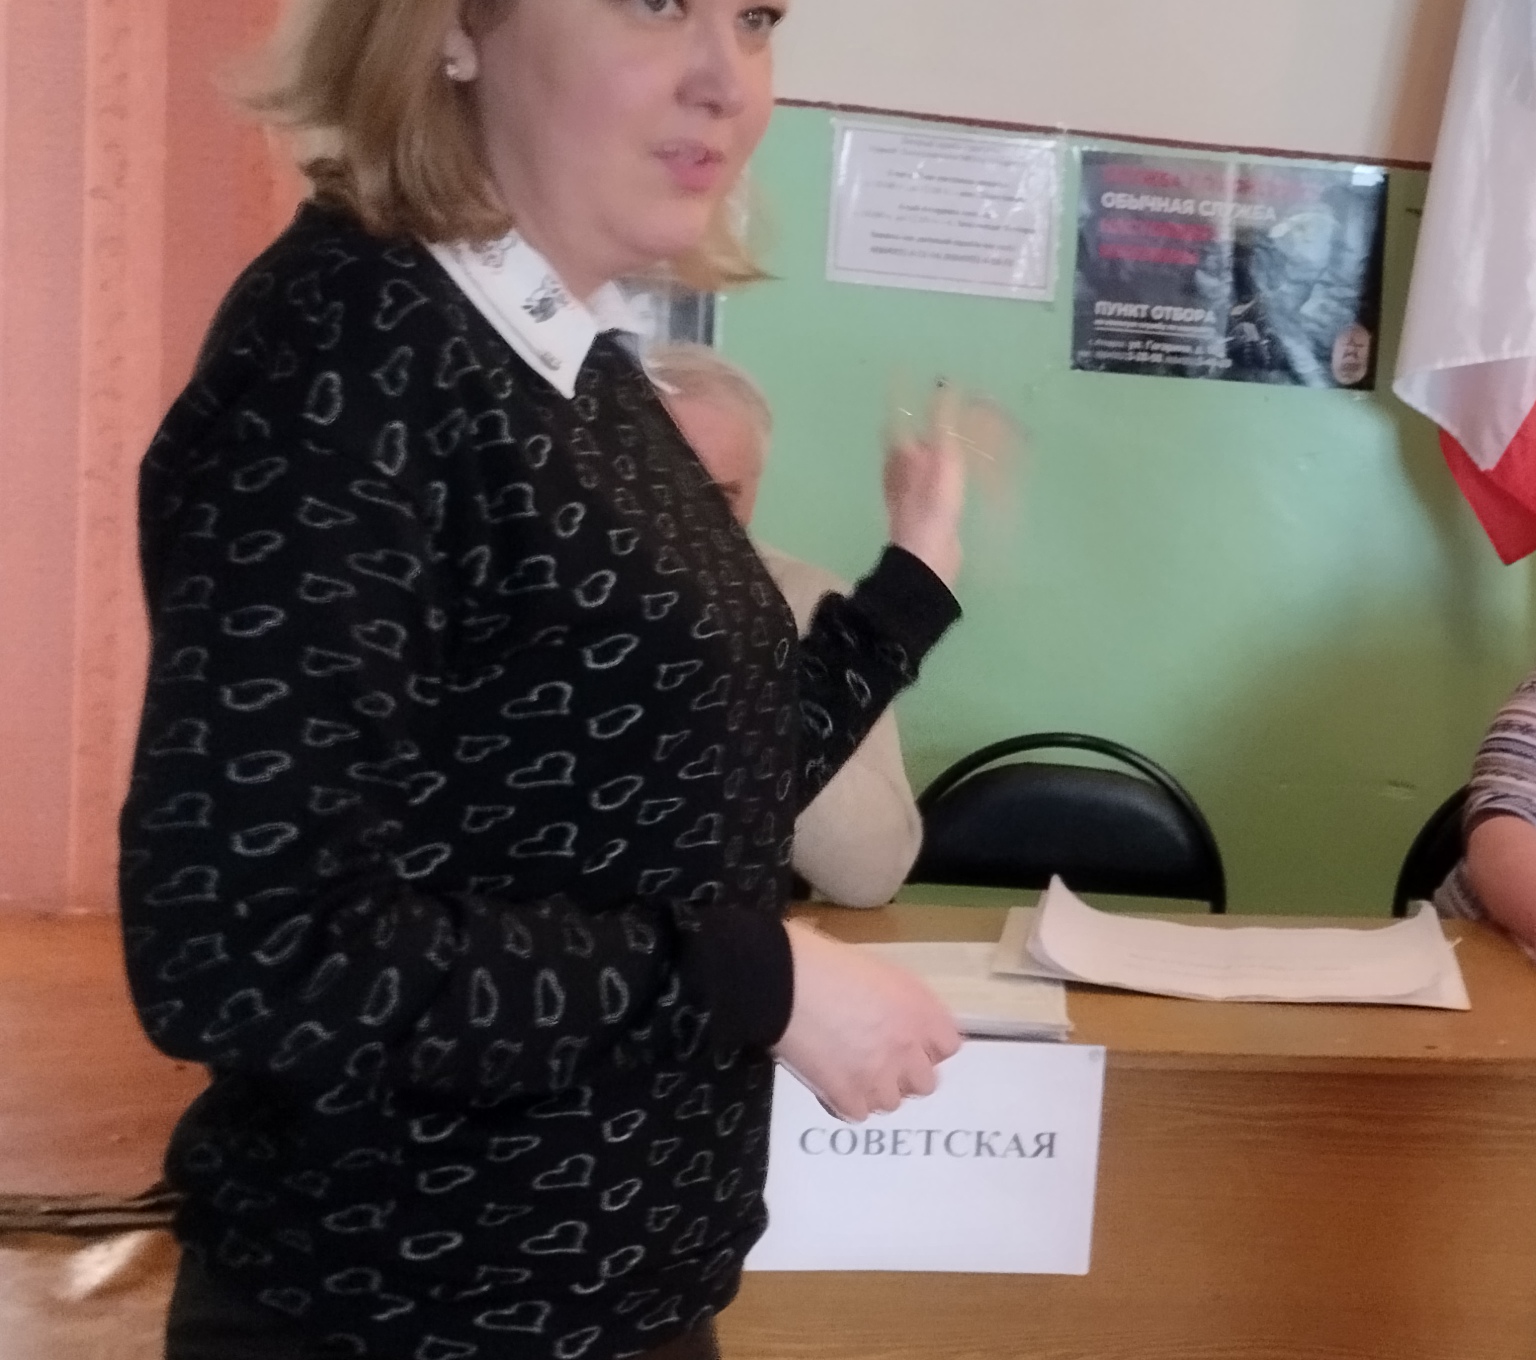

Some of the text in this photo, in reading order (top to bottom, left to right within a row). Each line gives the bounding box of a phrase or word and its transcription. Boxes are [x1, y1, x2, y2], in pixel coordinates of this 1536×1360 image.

[1101, 191, 1277, 221] ОБЫЧНАЯ СЛУЖБА
[1094, 301, 1216, 322] ПУНКТ ОТБОРА
[798, 1126, 1058, 1159] СОВЕТСКАЯ
